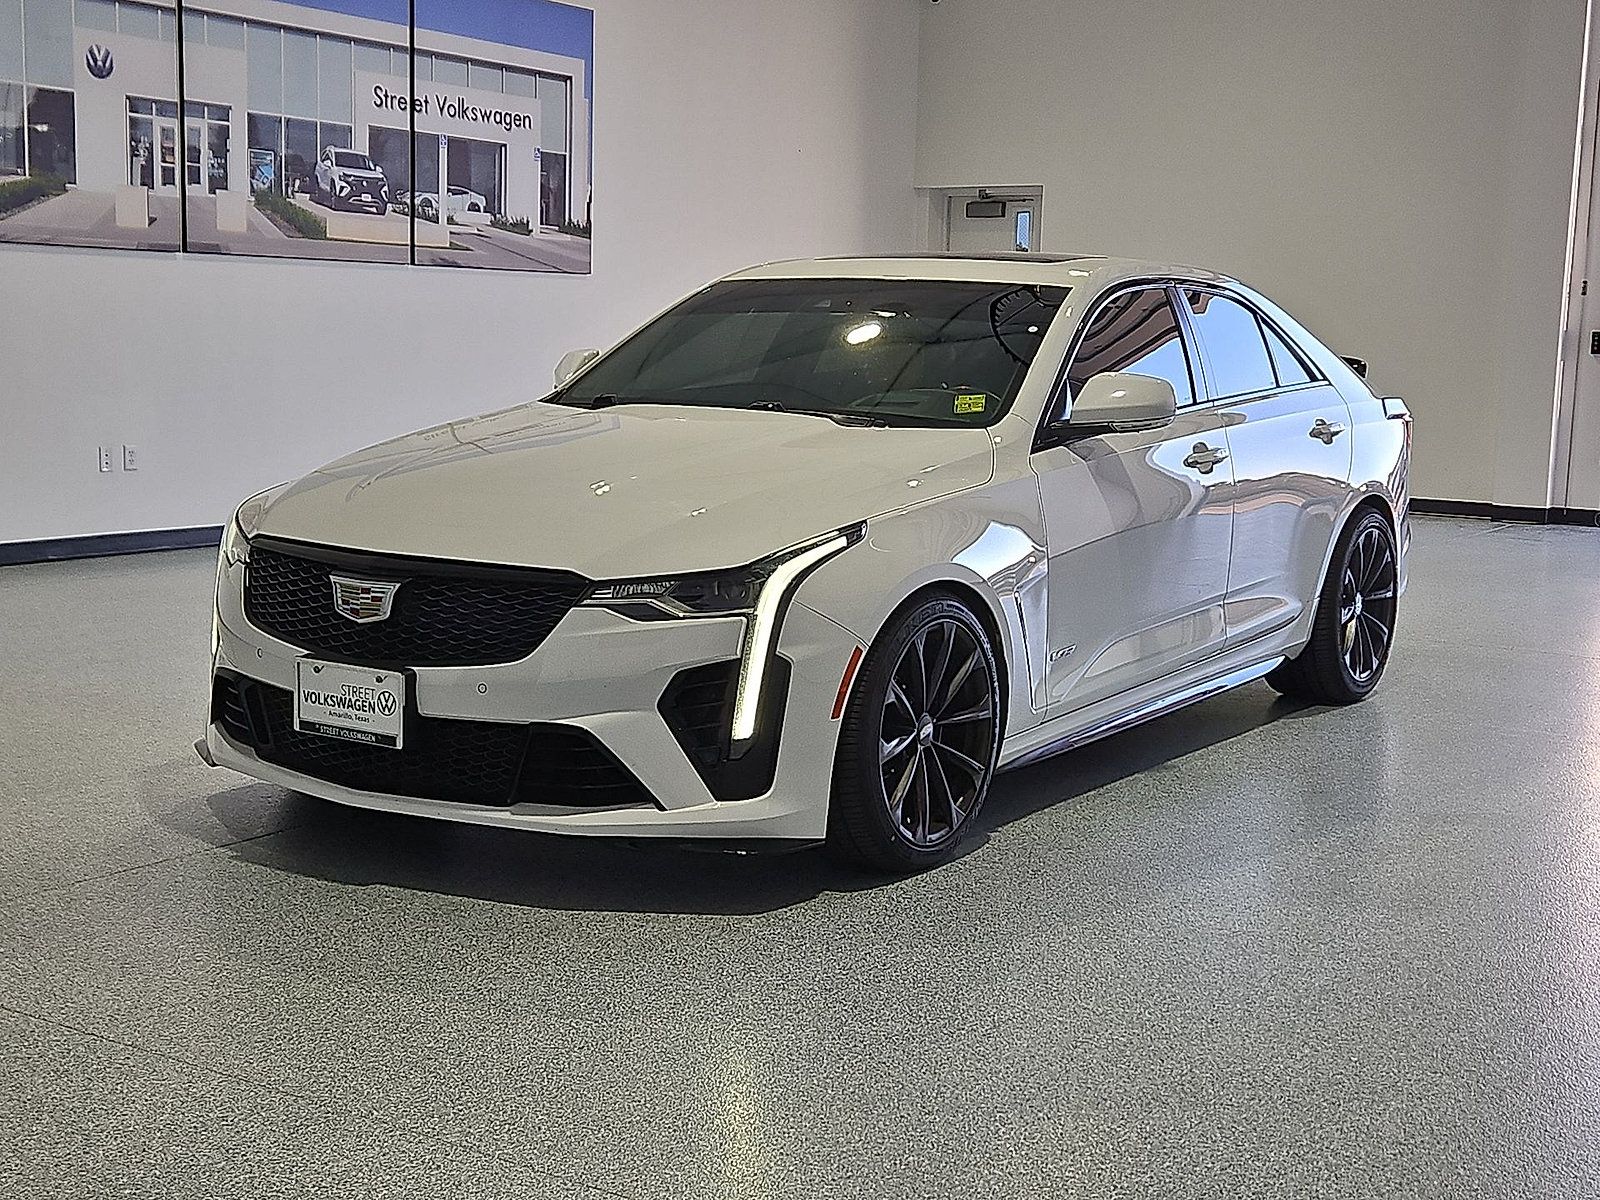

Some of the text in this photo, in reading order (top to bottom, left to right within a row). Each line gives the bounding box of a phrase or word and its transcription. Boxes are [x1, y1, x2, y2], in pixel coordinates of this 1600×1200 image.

[373, 84, 533, 132] Street Volkswagen
[340, 683, 376, 701] STREET
[302, 689, 376, 715] VOLKSWAGEN
[354, 713, 370, 723] Texas
[320, 725, 376, 742] STREET VOLKSWAGEN
